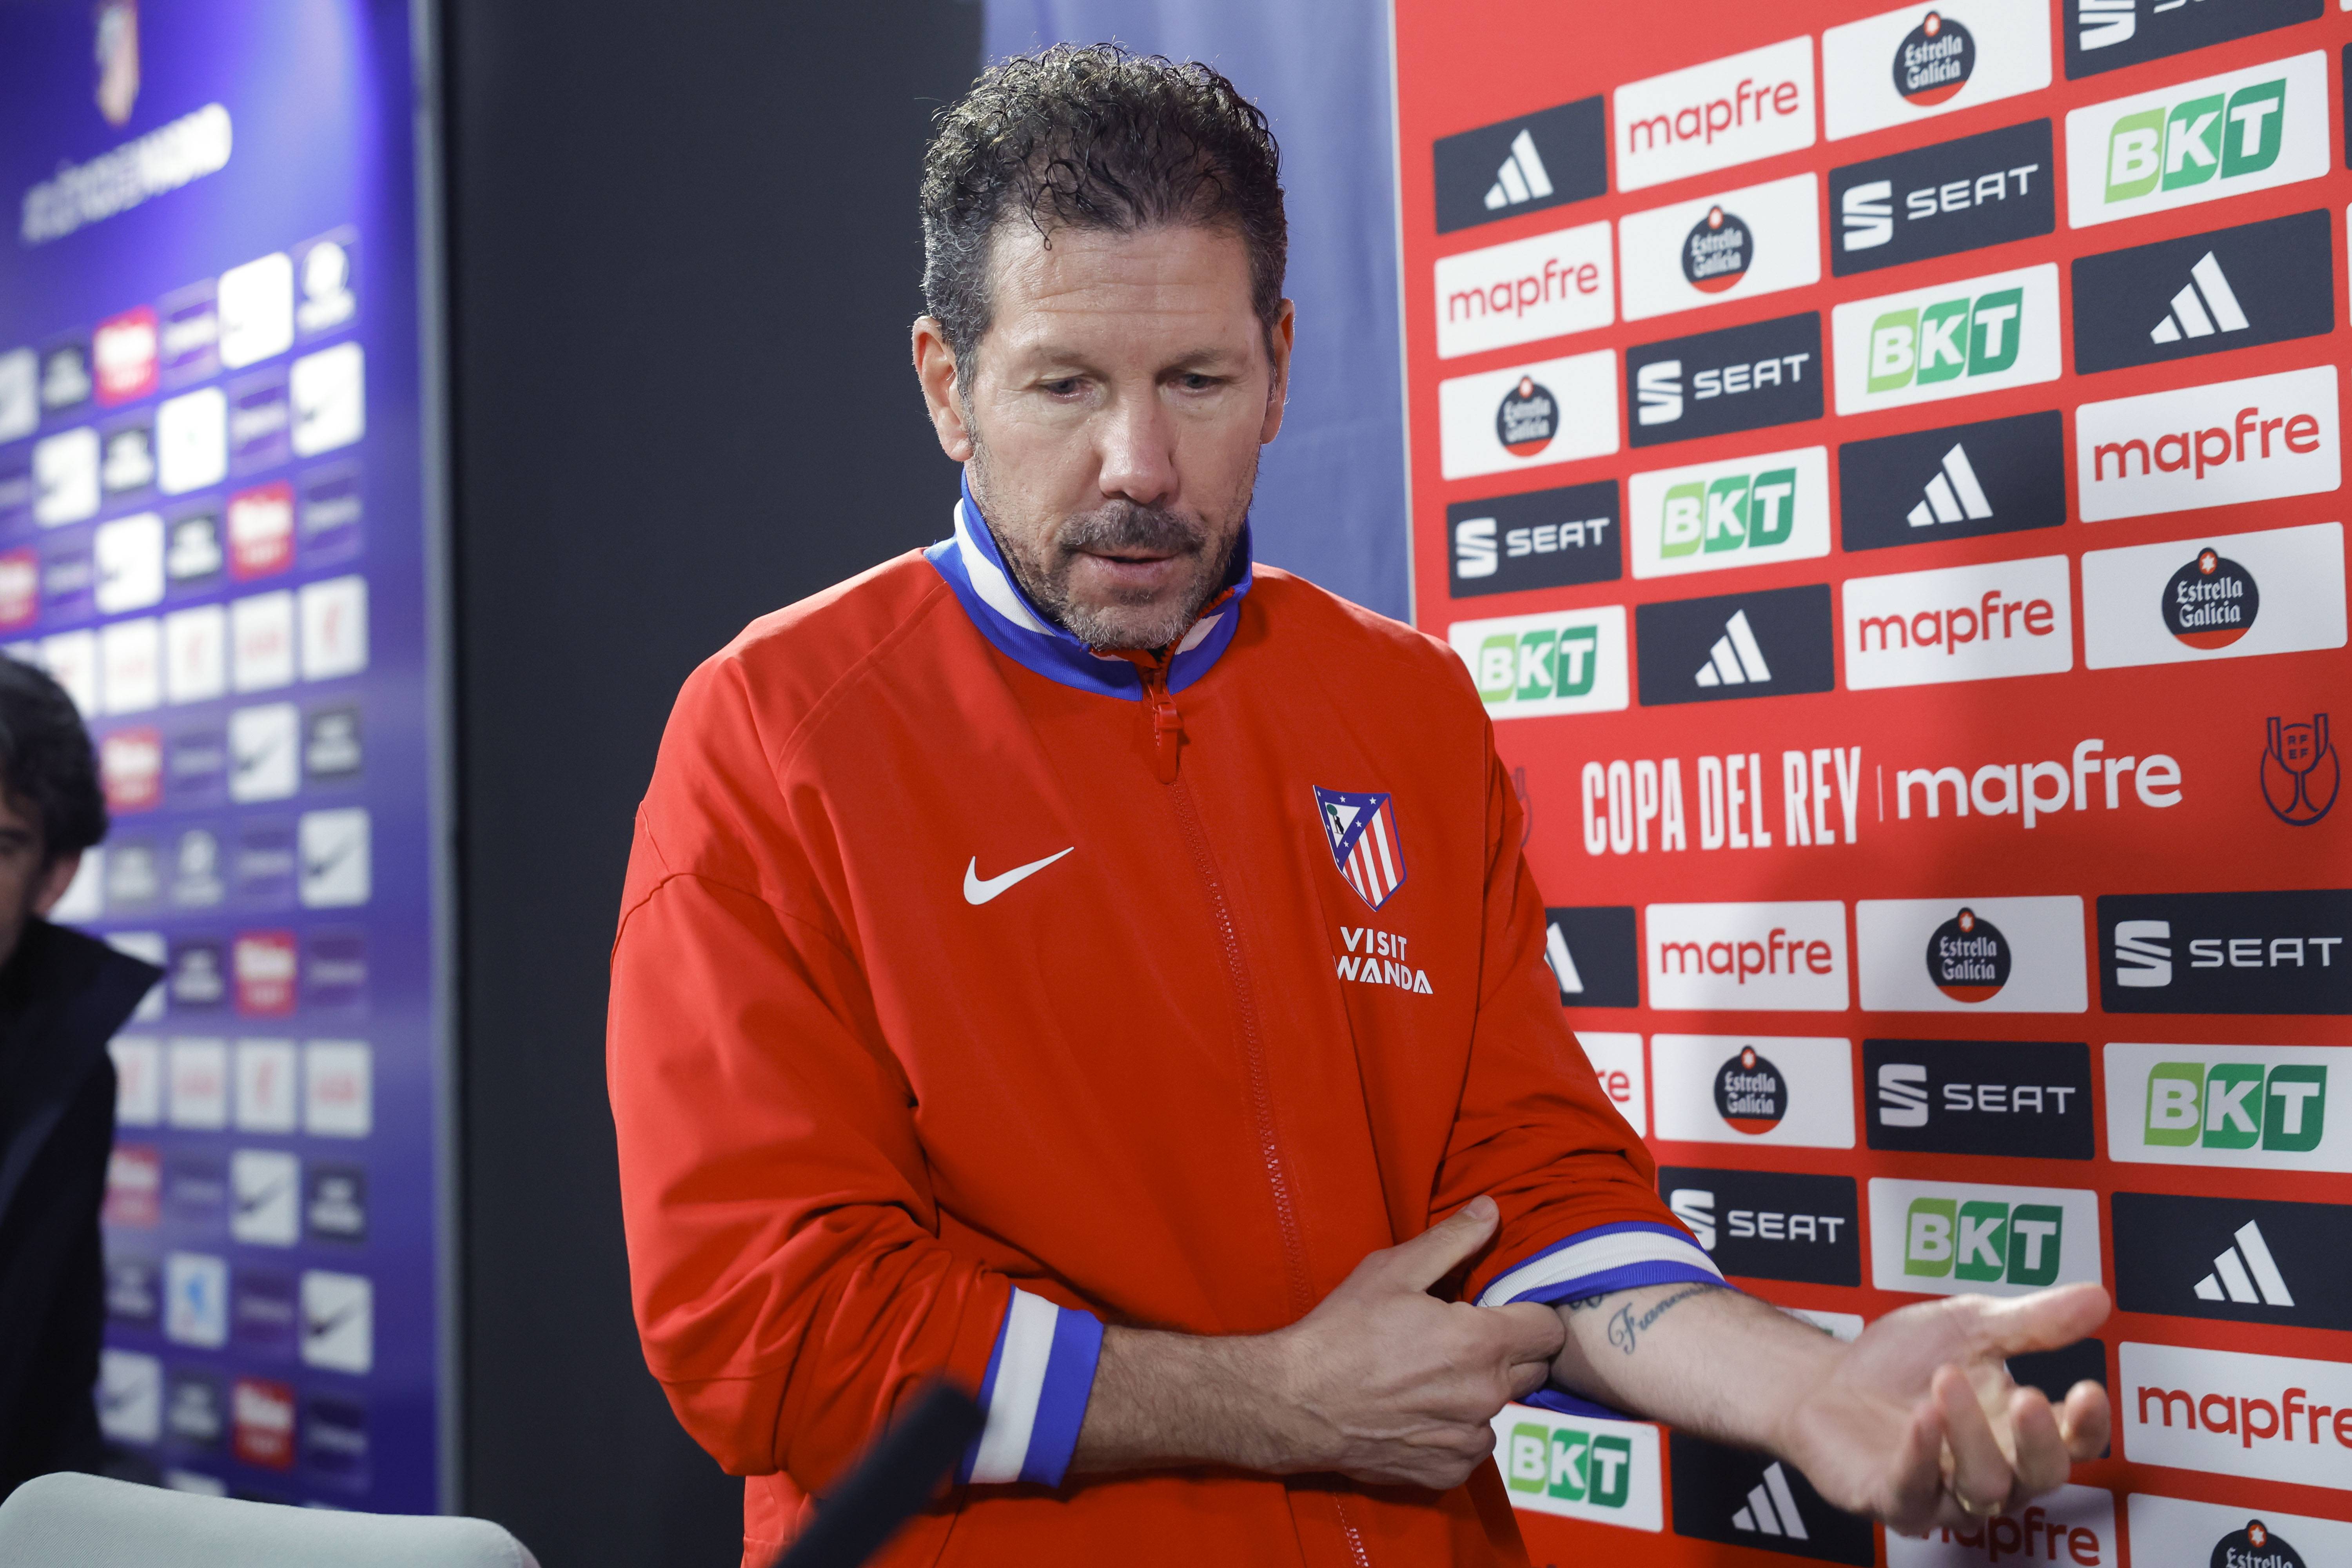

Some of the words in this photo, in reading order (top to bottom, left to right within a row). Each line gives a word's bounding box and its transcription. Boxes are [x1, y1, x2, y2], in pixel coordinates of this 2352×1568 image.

[1904, 34, 1963, 67] Estrella
[1907, 56, 1962, 89] Galicia
[1630, 78, 1799, 153] mapfre
[2109, 96, 2280, 186] BKT
[1906, 163, 2039, 221] SEAT
[1449, 258, 1599, 321] mapfre
[1871, 303, 2018, 379] BKT
[1693, 352, 1810, 400] SEAT
[2094, 407, 2321, 482] mapfre
[1505, 517, 1611, 557] SEAT
[1662, 481, 1792, 546] BKT
[2176, 576, 2243, 604] Estrella
[2179, 600, 2241, 628] Galicia
[1859, 590, 2055, 656] mapfre
[1479, 637, 1595, 692] BKT
[1581, 757, 1687, 856] COPA
[1697, 752, 1772, 850] DEL
[1782, 746, 1862, 847] REY
[1896, 738, 2183, 829] mapfre
[1339, 926, 1407, 962] VISIT
[1660, 927, 1833, 985] mapfre
[1940, 936, 1996, 957] Estrella
[1942, 958, 1995, 980] Galicia
[2189, 937, 2343, 967] SEAT
[1333, 955, 1434, 995] WANDA
[1943, 1083, 2076, 1114] SEAT
[2149, 1078, 2321, 1134] BKT
[1727, 1210, 1845, 1243] SEAT
[1908, 1212, 2056, 1271] BKT
[1512, 1435, 1628, 1494] BKT
